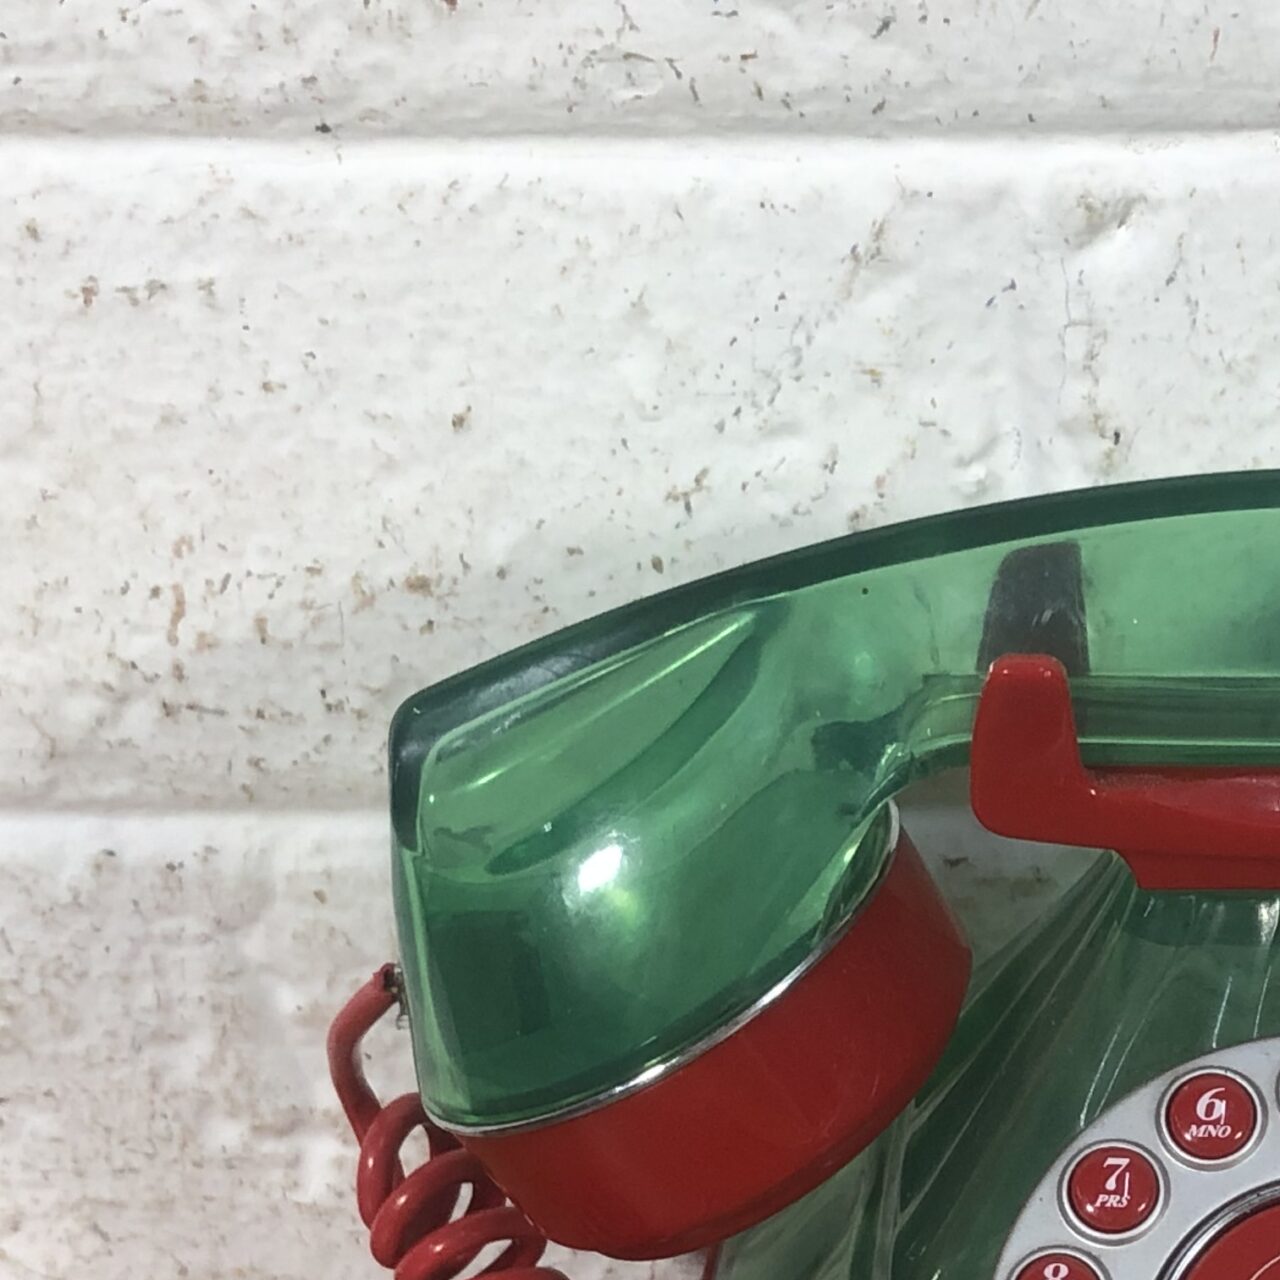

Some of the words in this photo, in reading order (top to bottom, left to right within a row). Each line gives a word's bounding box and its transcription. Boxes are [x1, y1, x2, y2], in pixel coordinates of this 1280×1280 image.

[1196, 1087, 1225, 1121] 6
[1188, 1124, 1231, 1138] MNO
[1103, 1157, 1130, 1191] 7
[1094, 1194, 1130, 1208] PRS
